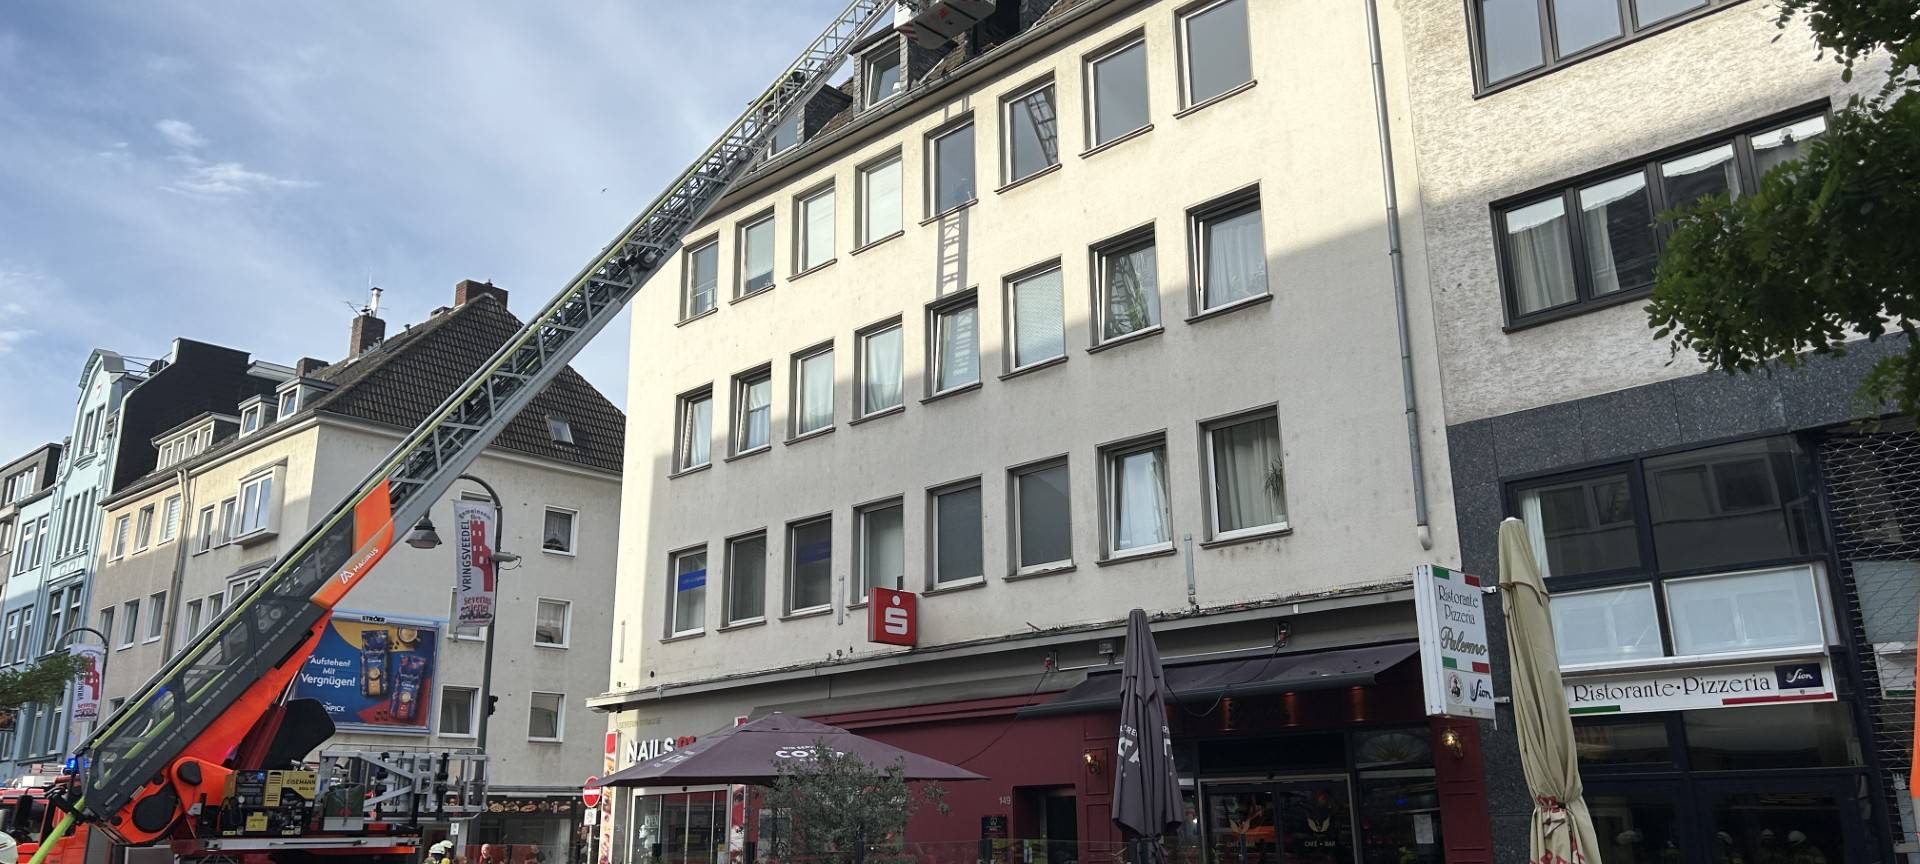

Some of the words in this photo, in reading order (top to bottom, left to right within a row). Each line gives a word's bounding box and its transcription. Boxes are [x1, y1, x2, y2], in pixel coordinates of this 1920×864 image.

[461, 520, 472, 592] VRINGSVEEDEL
[1438, 585, 1479, 609] Ristorante
[1444, 604, 1476, 625] Pizzeria
[1440, 626, 1488, 656] Palermo
[300, 672, 356, 688] Vergnügen!
[322, 667, 336, 675] Mit
[626, 737, 674, 763] NAILS
